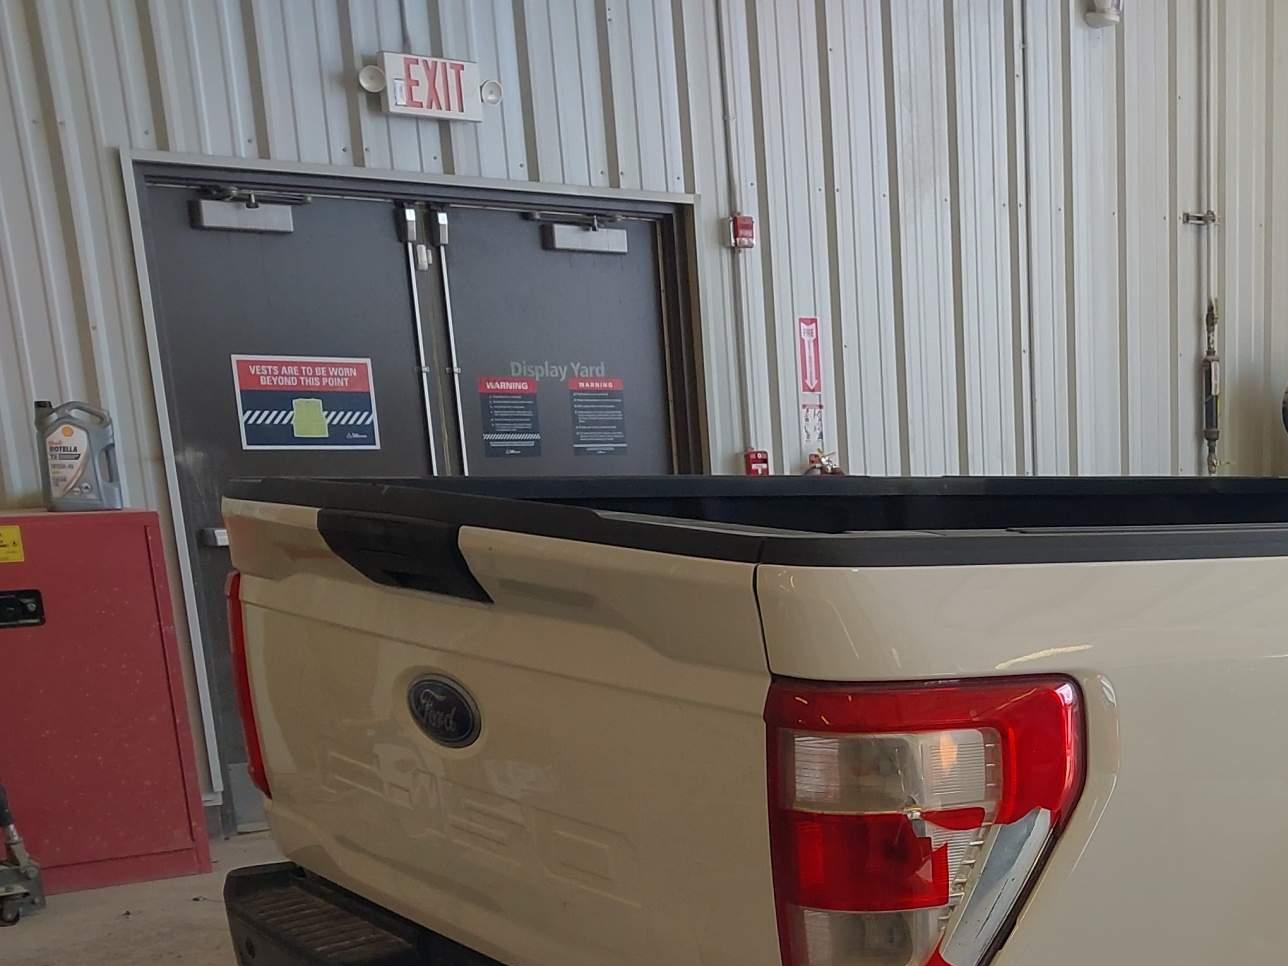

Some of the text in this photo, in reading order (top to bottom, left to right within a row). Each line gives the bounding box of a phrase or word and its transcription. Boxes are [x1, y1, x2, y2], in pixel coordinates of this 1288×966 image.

[403, 56, 465, 113] EXIT
[248, 365, 357, 377] VESTS ARE TO BE WORN
[510, 361, 606, 381] Display Yard
[260, 375, 350, 387] BEYOND THIS POINT
[486, 381, 529, 390] WARNING
[420, 688, 458, 732] Ford
